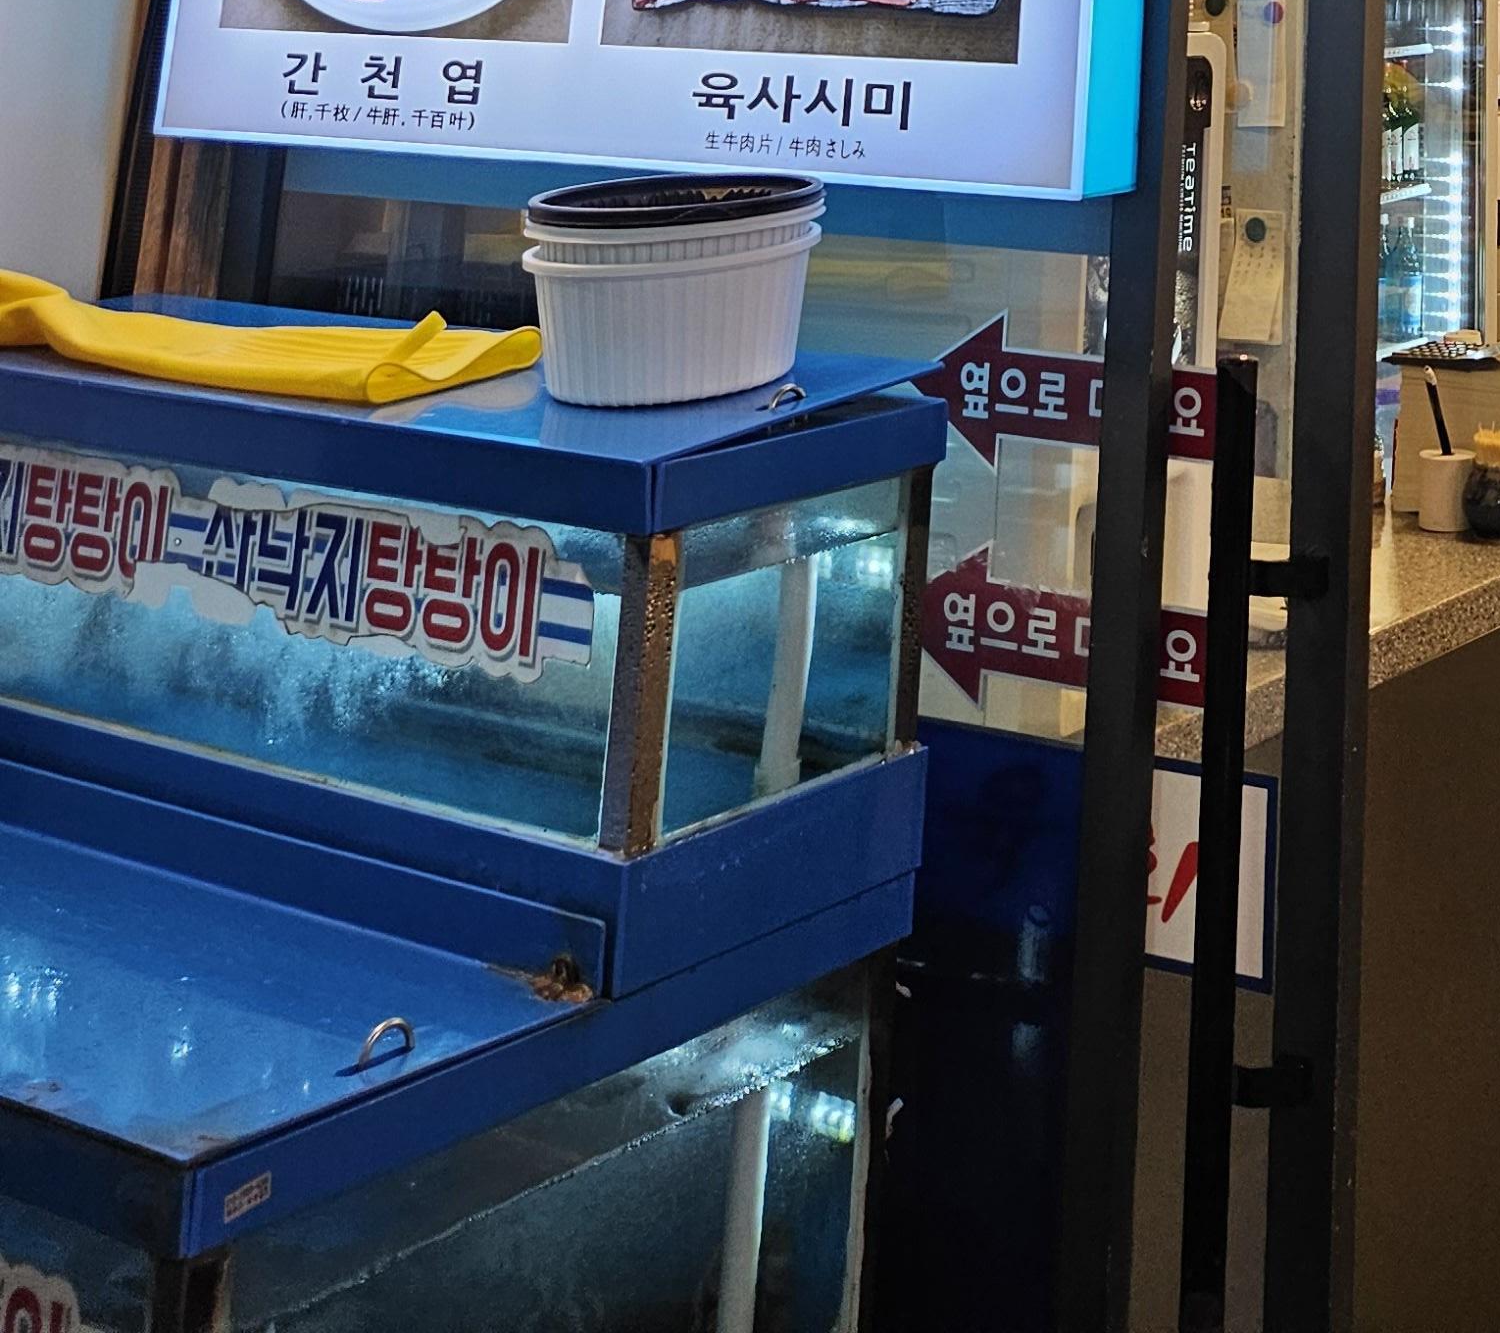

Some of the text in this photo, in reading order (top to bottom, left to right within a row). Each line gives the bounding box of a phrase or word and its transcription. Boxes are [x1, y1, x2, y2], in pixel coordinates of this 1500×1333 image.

[692, 72, 912, 131] 육사시미
[960, 361, 1068, 420] 옆으로
[943, 592, 1060, 660] 옆으로
